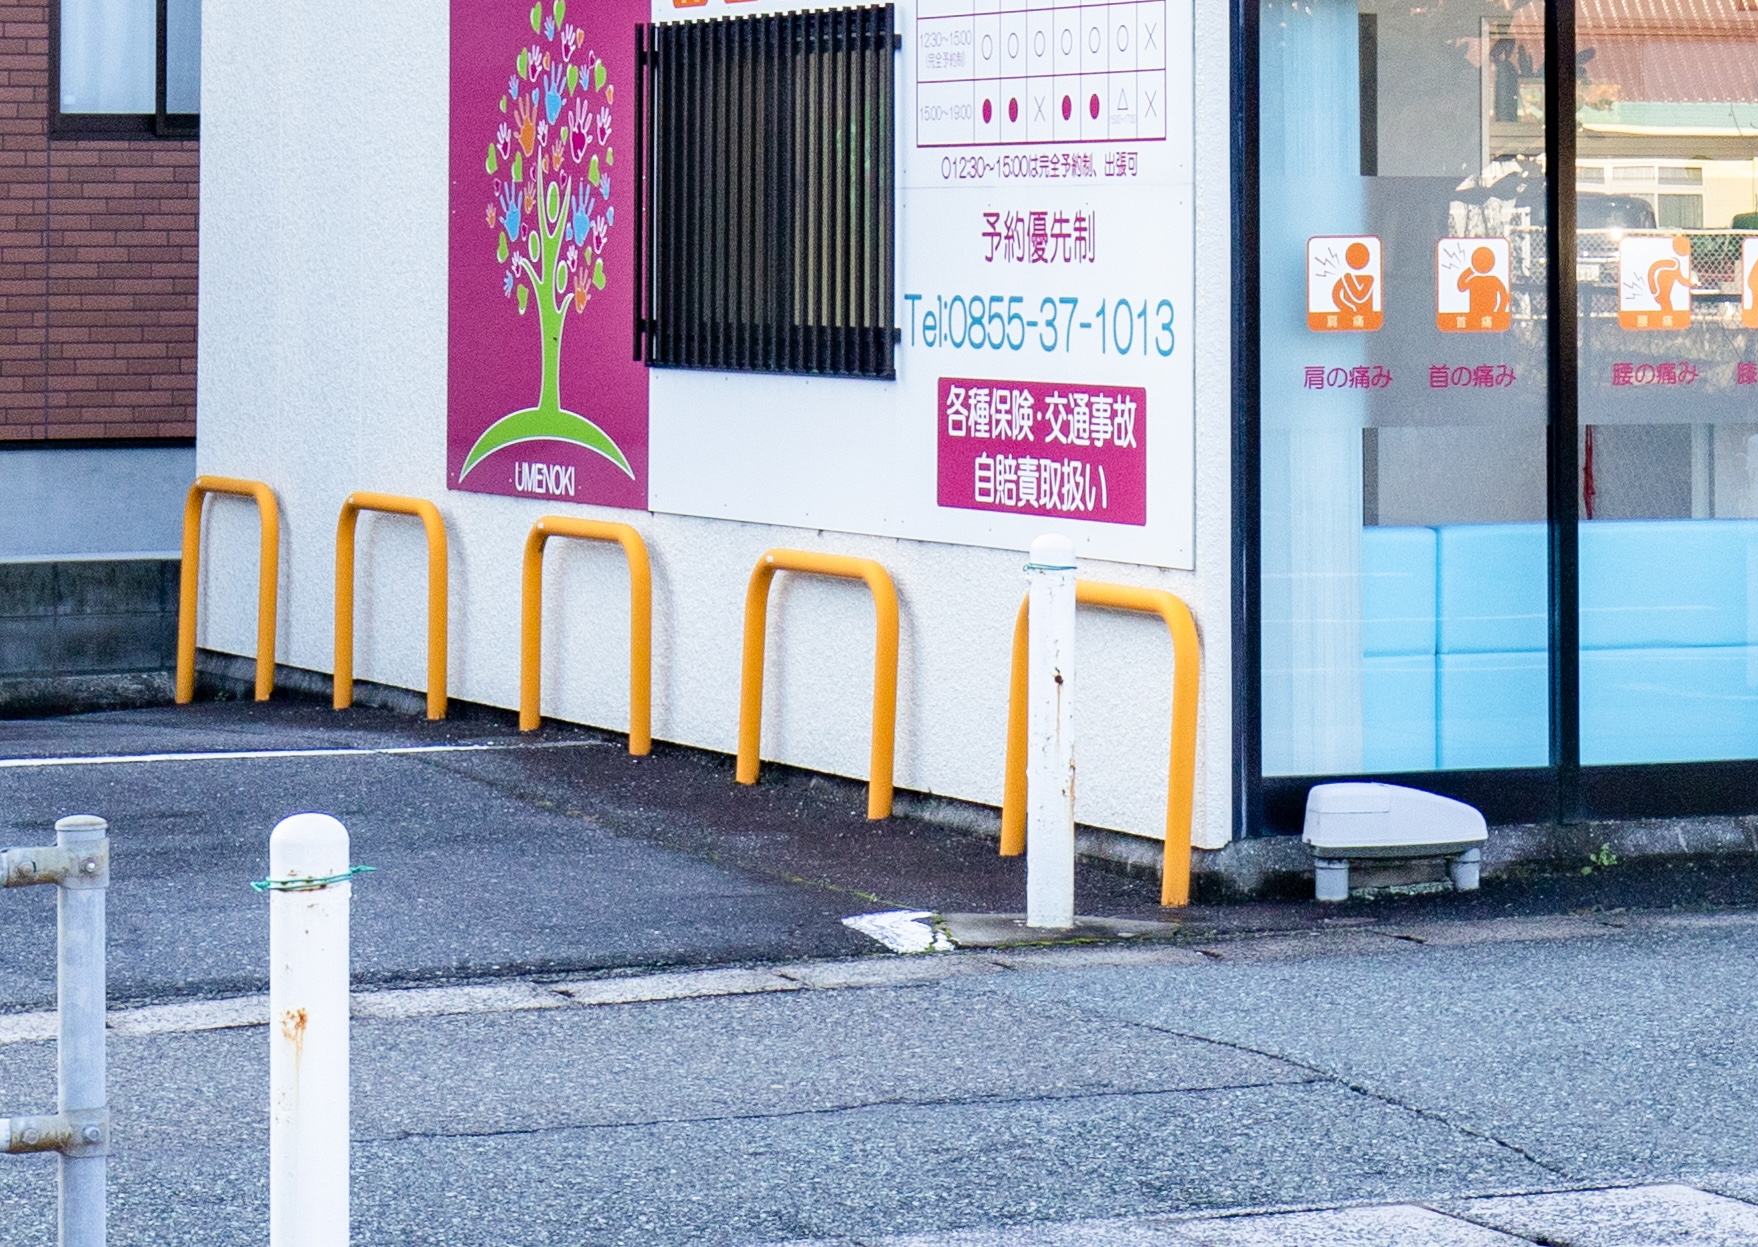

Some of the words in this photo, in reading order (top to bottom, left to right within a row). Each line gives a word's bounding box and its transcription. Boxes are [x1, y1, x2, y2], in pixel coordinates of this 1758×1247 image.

[981, 209, 1096, 265] 予約優先制
[904, 293, 1176, 358] Tel:0855-37-1013
[1303, 364, 1393, 390] 肩の痛み
[1428, 363, 1517, 389] 首の痛み
[1611, 361, 1699, 387] 腰の痛み
[514, 461, 576, 497] UMENOKI
[974, 451, 1108, 509] 自賠責取扱い
